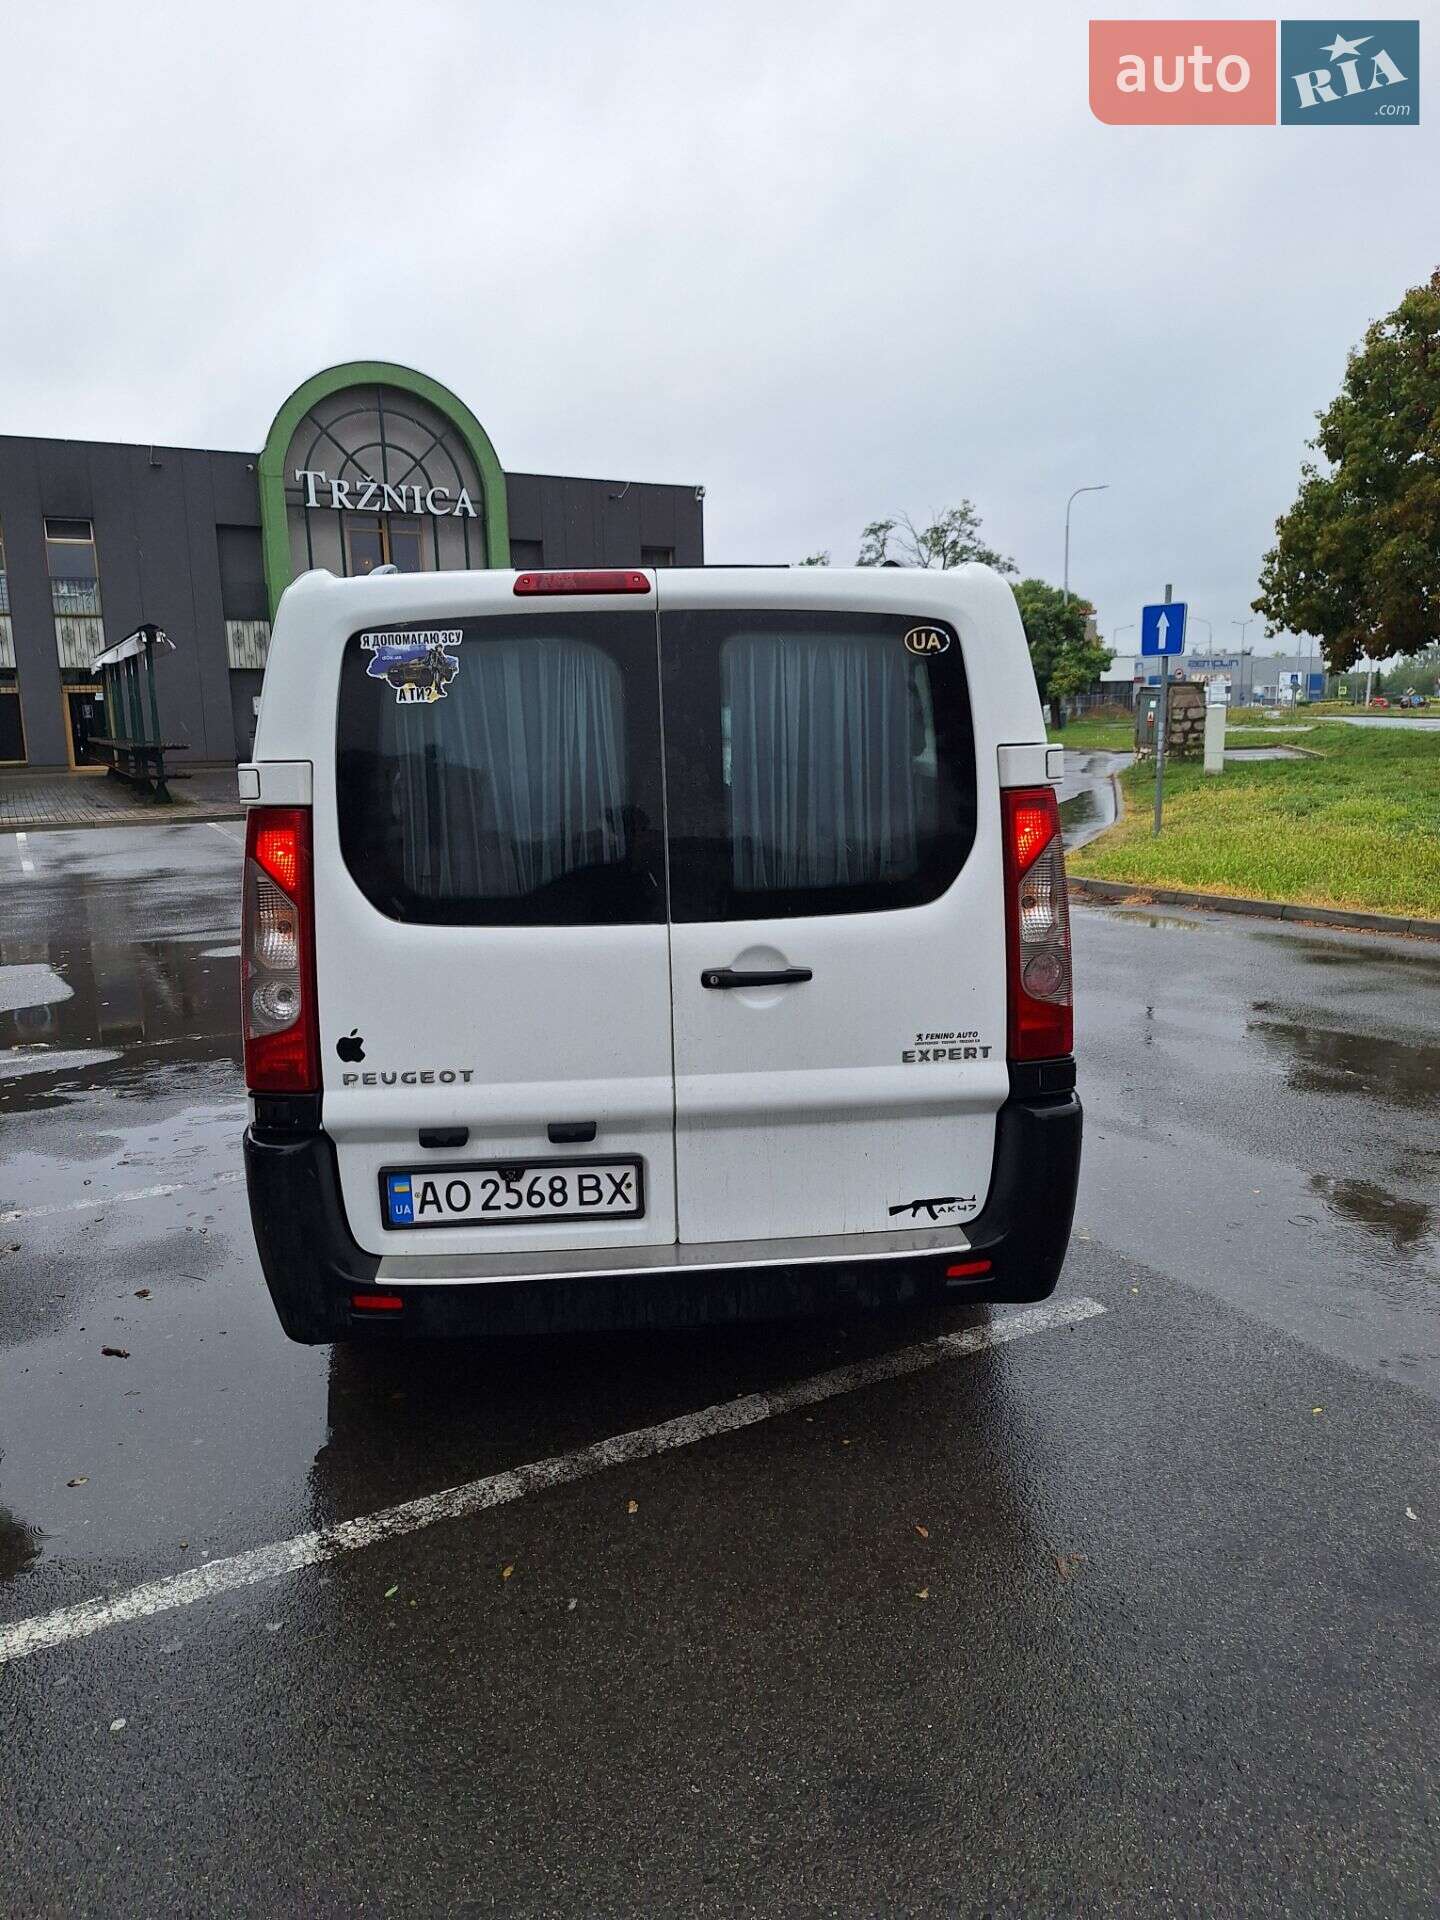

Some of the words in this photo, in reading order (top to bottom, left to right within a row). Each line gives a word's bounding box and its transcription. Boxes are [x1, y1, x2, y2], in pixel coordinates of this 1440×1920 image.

[294, 468, 478, 518] TRŽNICA
[363, 635, 370, 647] Я
[372, 632, 440, 647] ДОПОМАГАЮ
[442, 630, 461, 643] ЗСУ
[913, 632, 941, 649] UA
[398, 688, 406, 701] А
[409, 687, 432, 701] ТИ?
[956, 1031, 979, 1039] AUTO
[902, 1046, 992, 1063] EXPERT
[342, 1069, 474, 1086] PEUGEOT
[418, 1179, 471, 1215] AO
[480, 1175, 569, 1211] 2568
[577, 1171, 632, 1207] BX
[395, 1204, 411, 1216] UA
[937, 1204, 977, 1214] AK47
